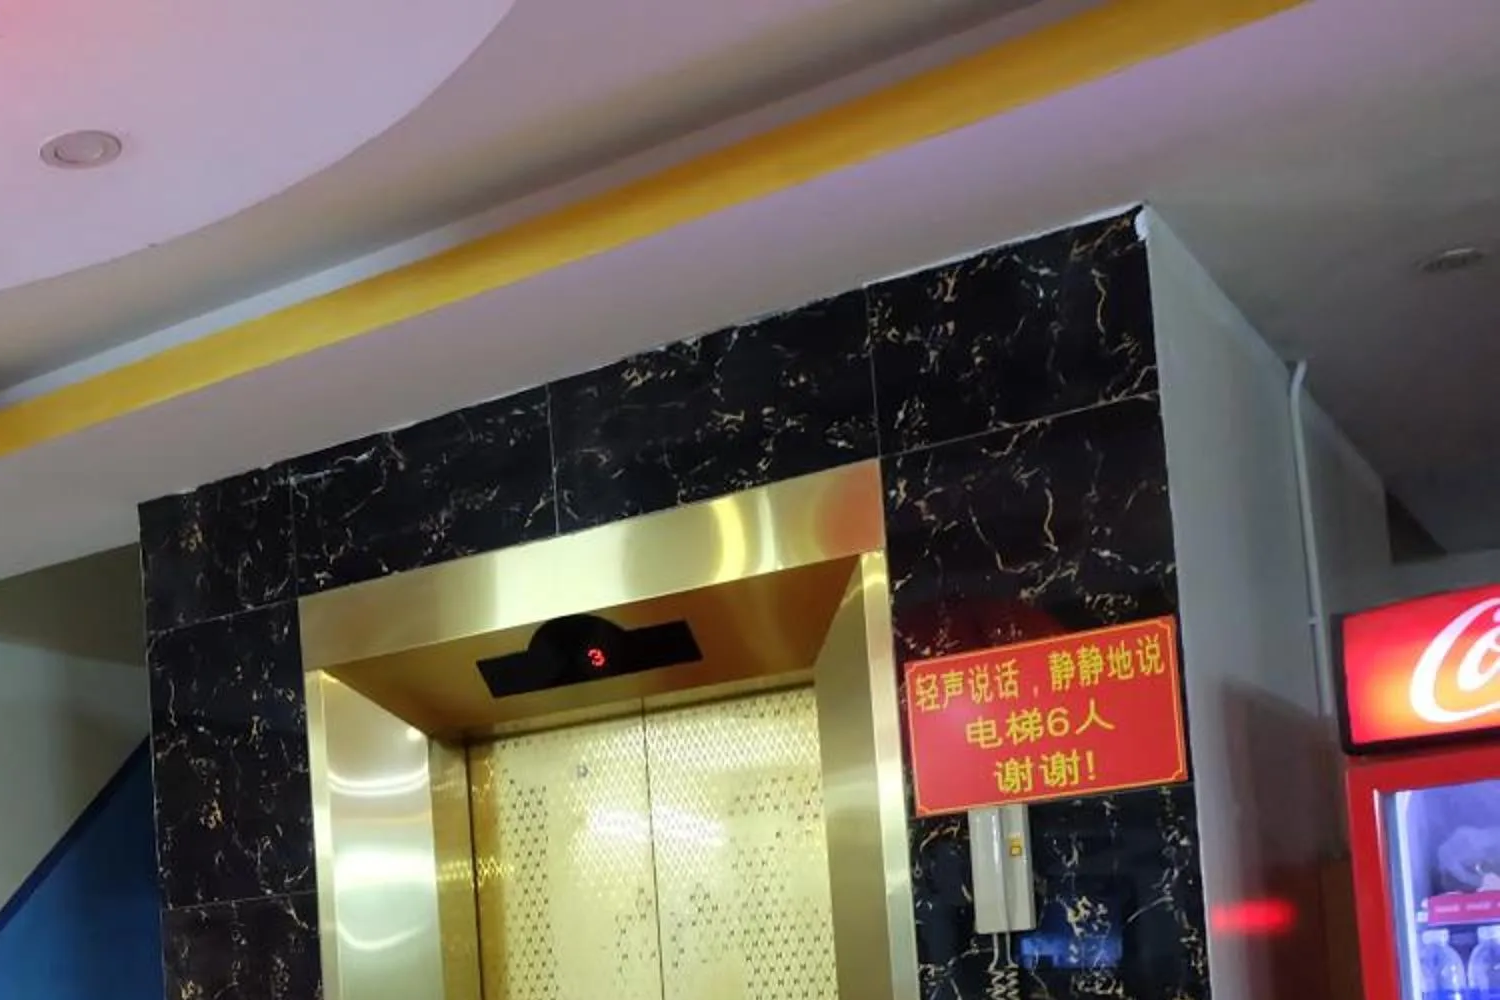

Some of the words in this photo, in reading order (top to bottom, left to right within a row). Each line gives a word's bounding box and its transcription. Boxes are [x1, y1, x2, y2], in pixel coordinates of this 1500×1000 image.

[588, 648, 605, 667] 3
[965, 697, 1116, 750] 电梯6人
